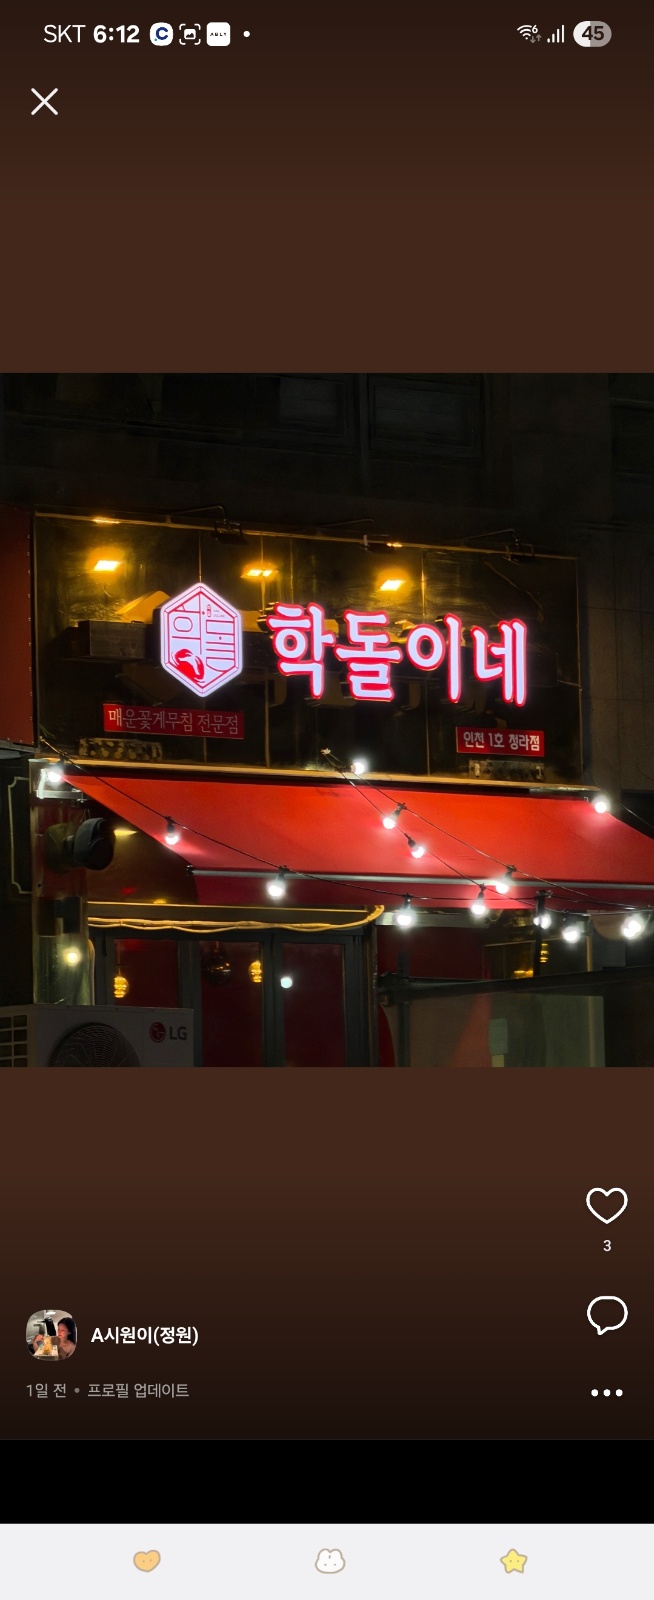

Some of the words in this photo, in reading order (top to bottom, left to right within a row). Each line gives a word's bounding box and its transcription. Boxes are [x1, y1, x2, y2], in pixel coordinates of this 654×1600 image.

[265, 601, 528, 708] 학돌이네
[108, 708, 193, 732] 매운꽃게무침
[197, 713, 238, 735] 전문점
[463, 731, 485, 748] 인천
[488, 732, 505, 748] 1호
[508, 734, 540, 751] 청라점
[169, 1026, 187, 1040] LG
